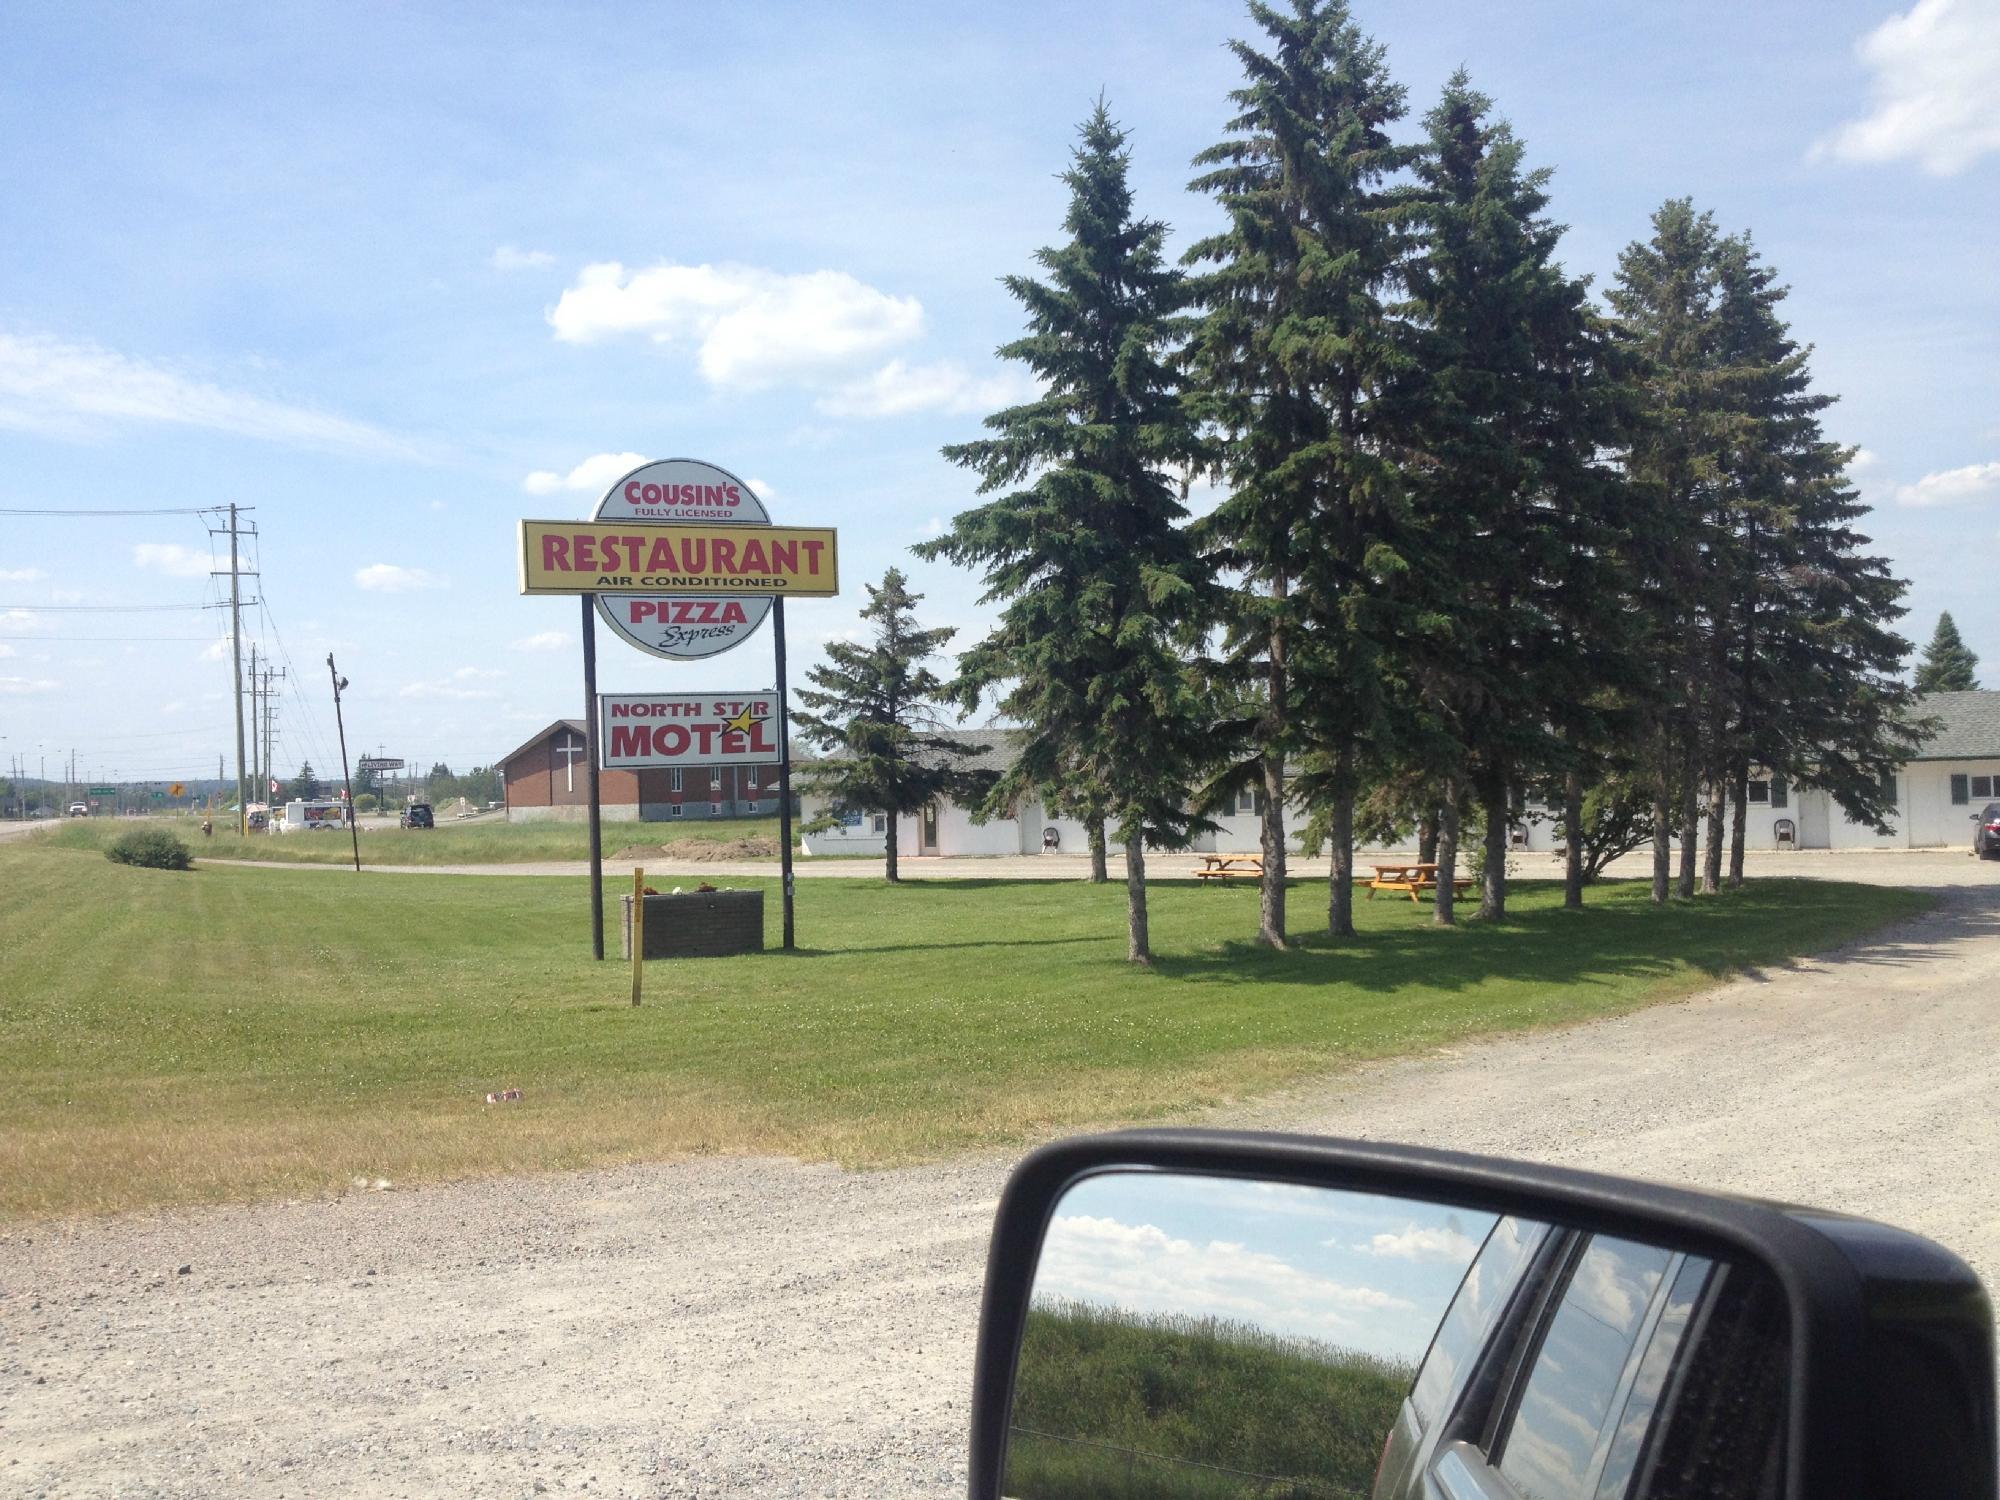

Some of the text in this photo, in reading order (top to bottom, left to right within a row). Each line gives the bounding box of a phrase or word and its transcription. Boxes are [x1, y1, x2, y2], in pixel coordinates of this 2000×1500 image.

[624, 481, 741, 507] COUSIN'S
[634, 508, 733, 518] FULLY LICENSED
[542, 534, 825, 576] RESTAURANT
[596, 576, 788, 587] AIR CONDITIONED
[630, 601, 747, 624] PIZZA
[658, 625, 736, 648] Express
[611, 702, 702, 718] NORTH
[610, 723, 776, 757] MOTEL
